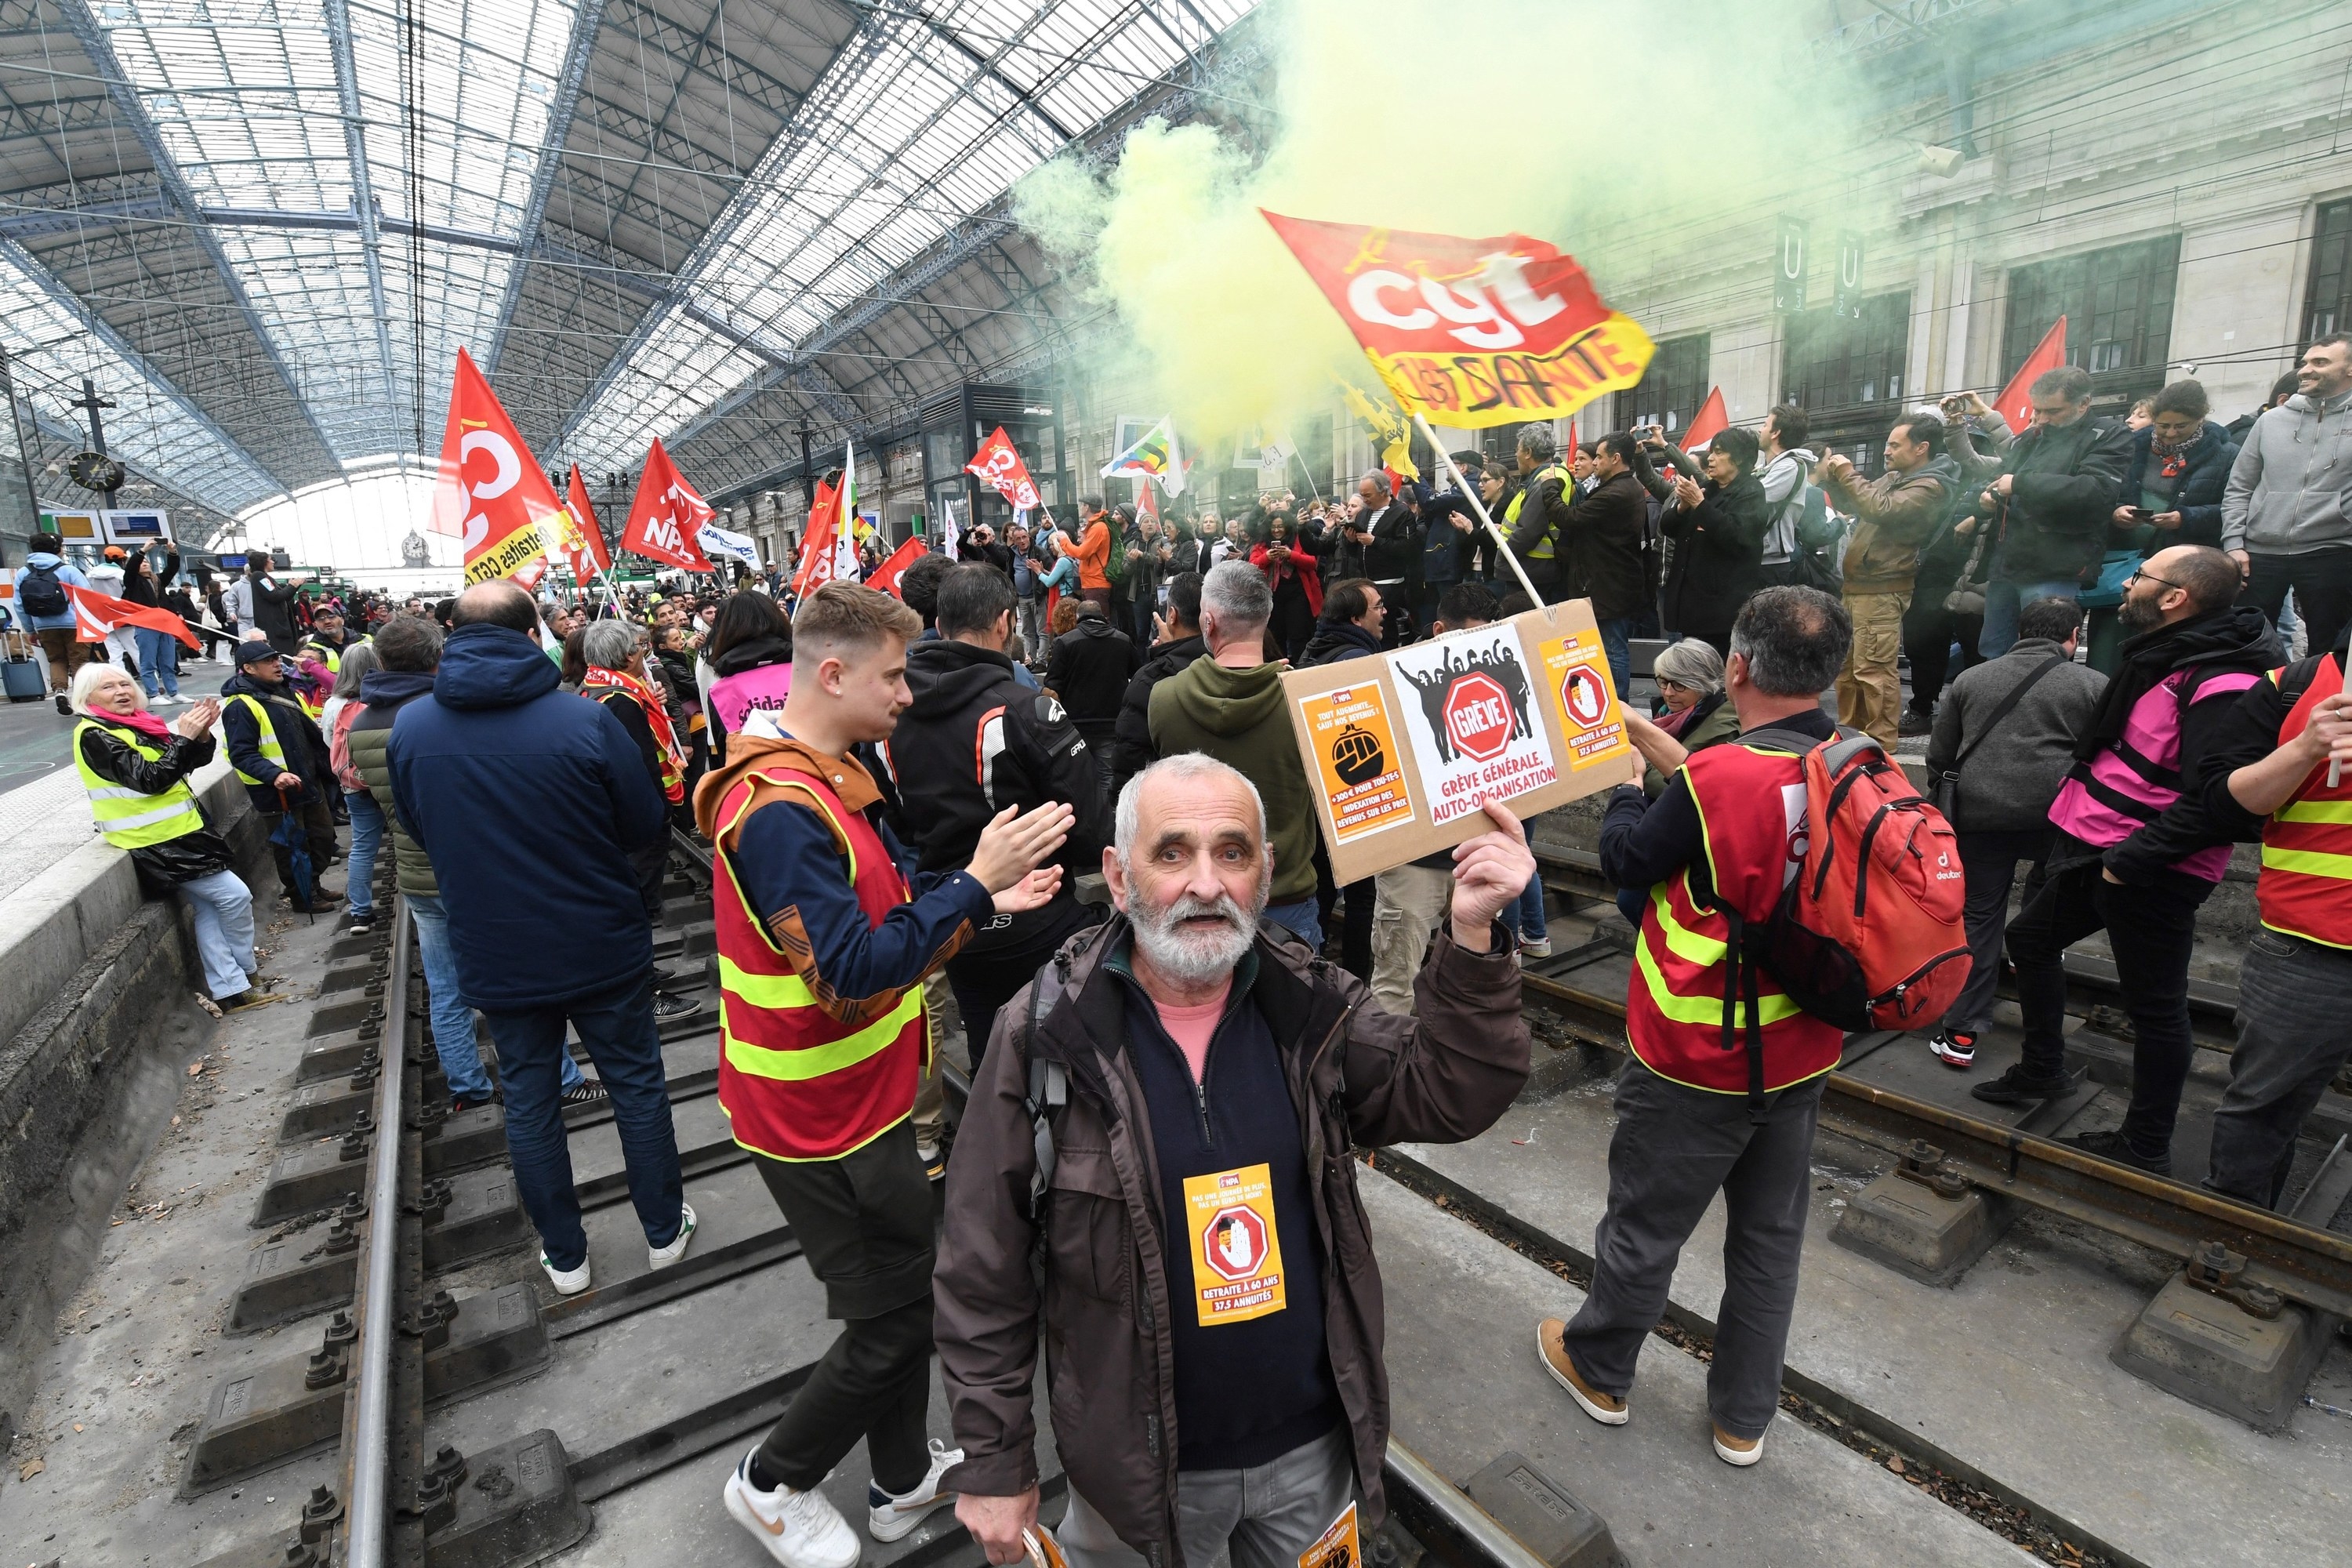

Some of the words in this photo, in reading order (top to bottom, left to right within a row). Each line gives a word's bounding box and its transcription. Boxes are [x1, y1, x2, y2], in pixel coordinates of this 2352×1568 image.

[1784, 235, 1802, 279] U
[1842, 246, 1858, 288] U
[1338, 693, 1352, 702] NPA
[1316, 722, 1333, 731] SAUF
[1334, 718, 1348, 727] NOS
[1348, 710, 1376, 724] REVENUS
[1317, 710, 1334, 721] TOUT
[1453, 696, 1506, 739] GRÈVE
[1570, 731, 1595, 747] RETRAITE
[1595, 728, 1601, 739] À
[1601, 727, 1608, 736] 60
[1609, 723, 1621, 733] ANS
[1592, 735, 1618, 752] ANNUITÉS
[1442, 771, 1480, 797] GRÈVE
[1483, 751, 1544, 783] GÉNÉRALE,
[1355, 782, 1374, 795] POUR
[1433, 765, 1556, 822] AUTO-ORGANISATION
[1342, 795, 1378, 815] INDEXATION
[1378, 790, 1394, 803] DES
[1337, 812, 1367, 829] REVENUS
[1367, 808, 1381, 818] SUR
[1381, 804, 1392, 815] LES
[1392, 798, 1407, 811] PRIX
[1936, 869, 1962, 880] deuter
[1225, 1177, 1240, 1186] NPA
[1218, 1187, 1243, 1199] JOURNÉE
[1221, 1196, 1236, 1205] EURO
[1245, 1190, 1263, 1200] MOINS
[1203, 1284, 1242, 1300] RETRAITE
[1243, 1280, 1250, 1293] À
[1250, 1279, 1261, 1290] 60
[1263, 1275, 1279, 1287] ANS
[1233, 1290, 1272, 1308] ANNUITÉS
[1308, 1547, 1323, 1560] TOUT
[1321, 1546, 1332, 1557] NOS
